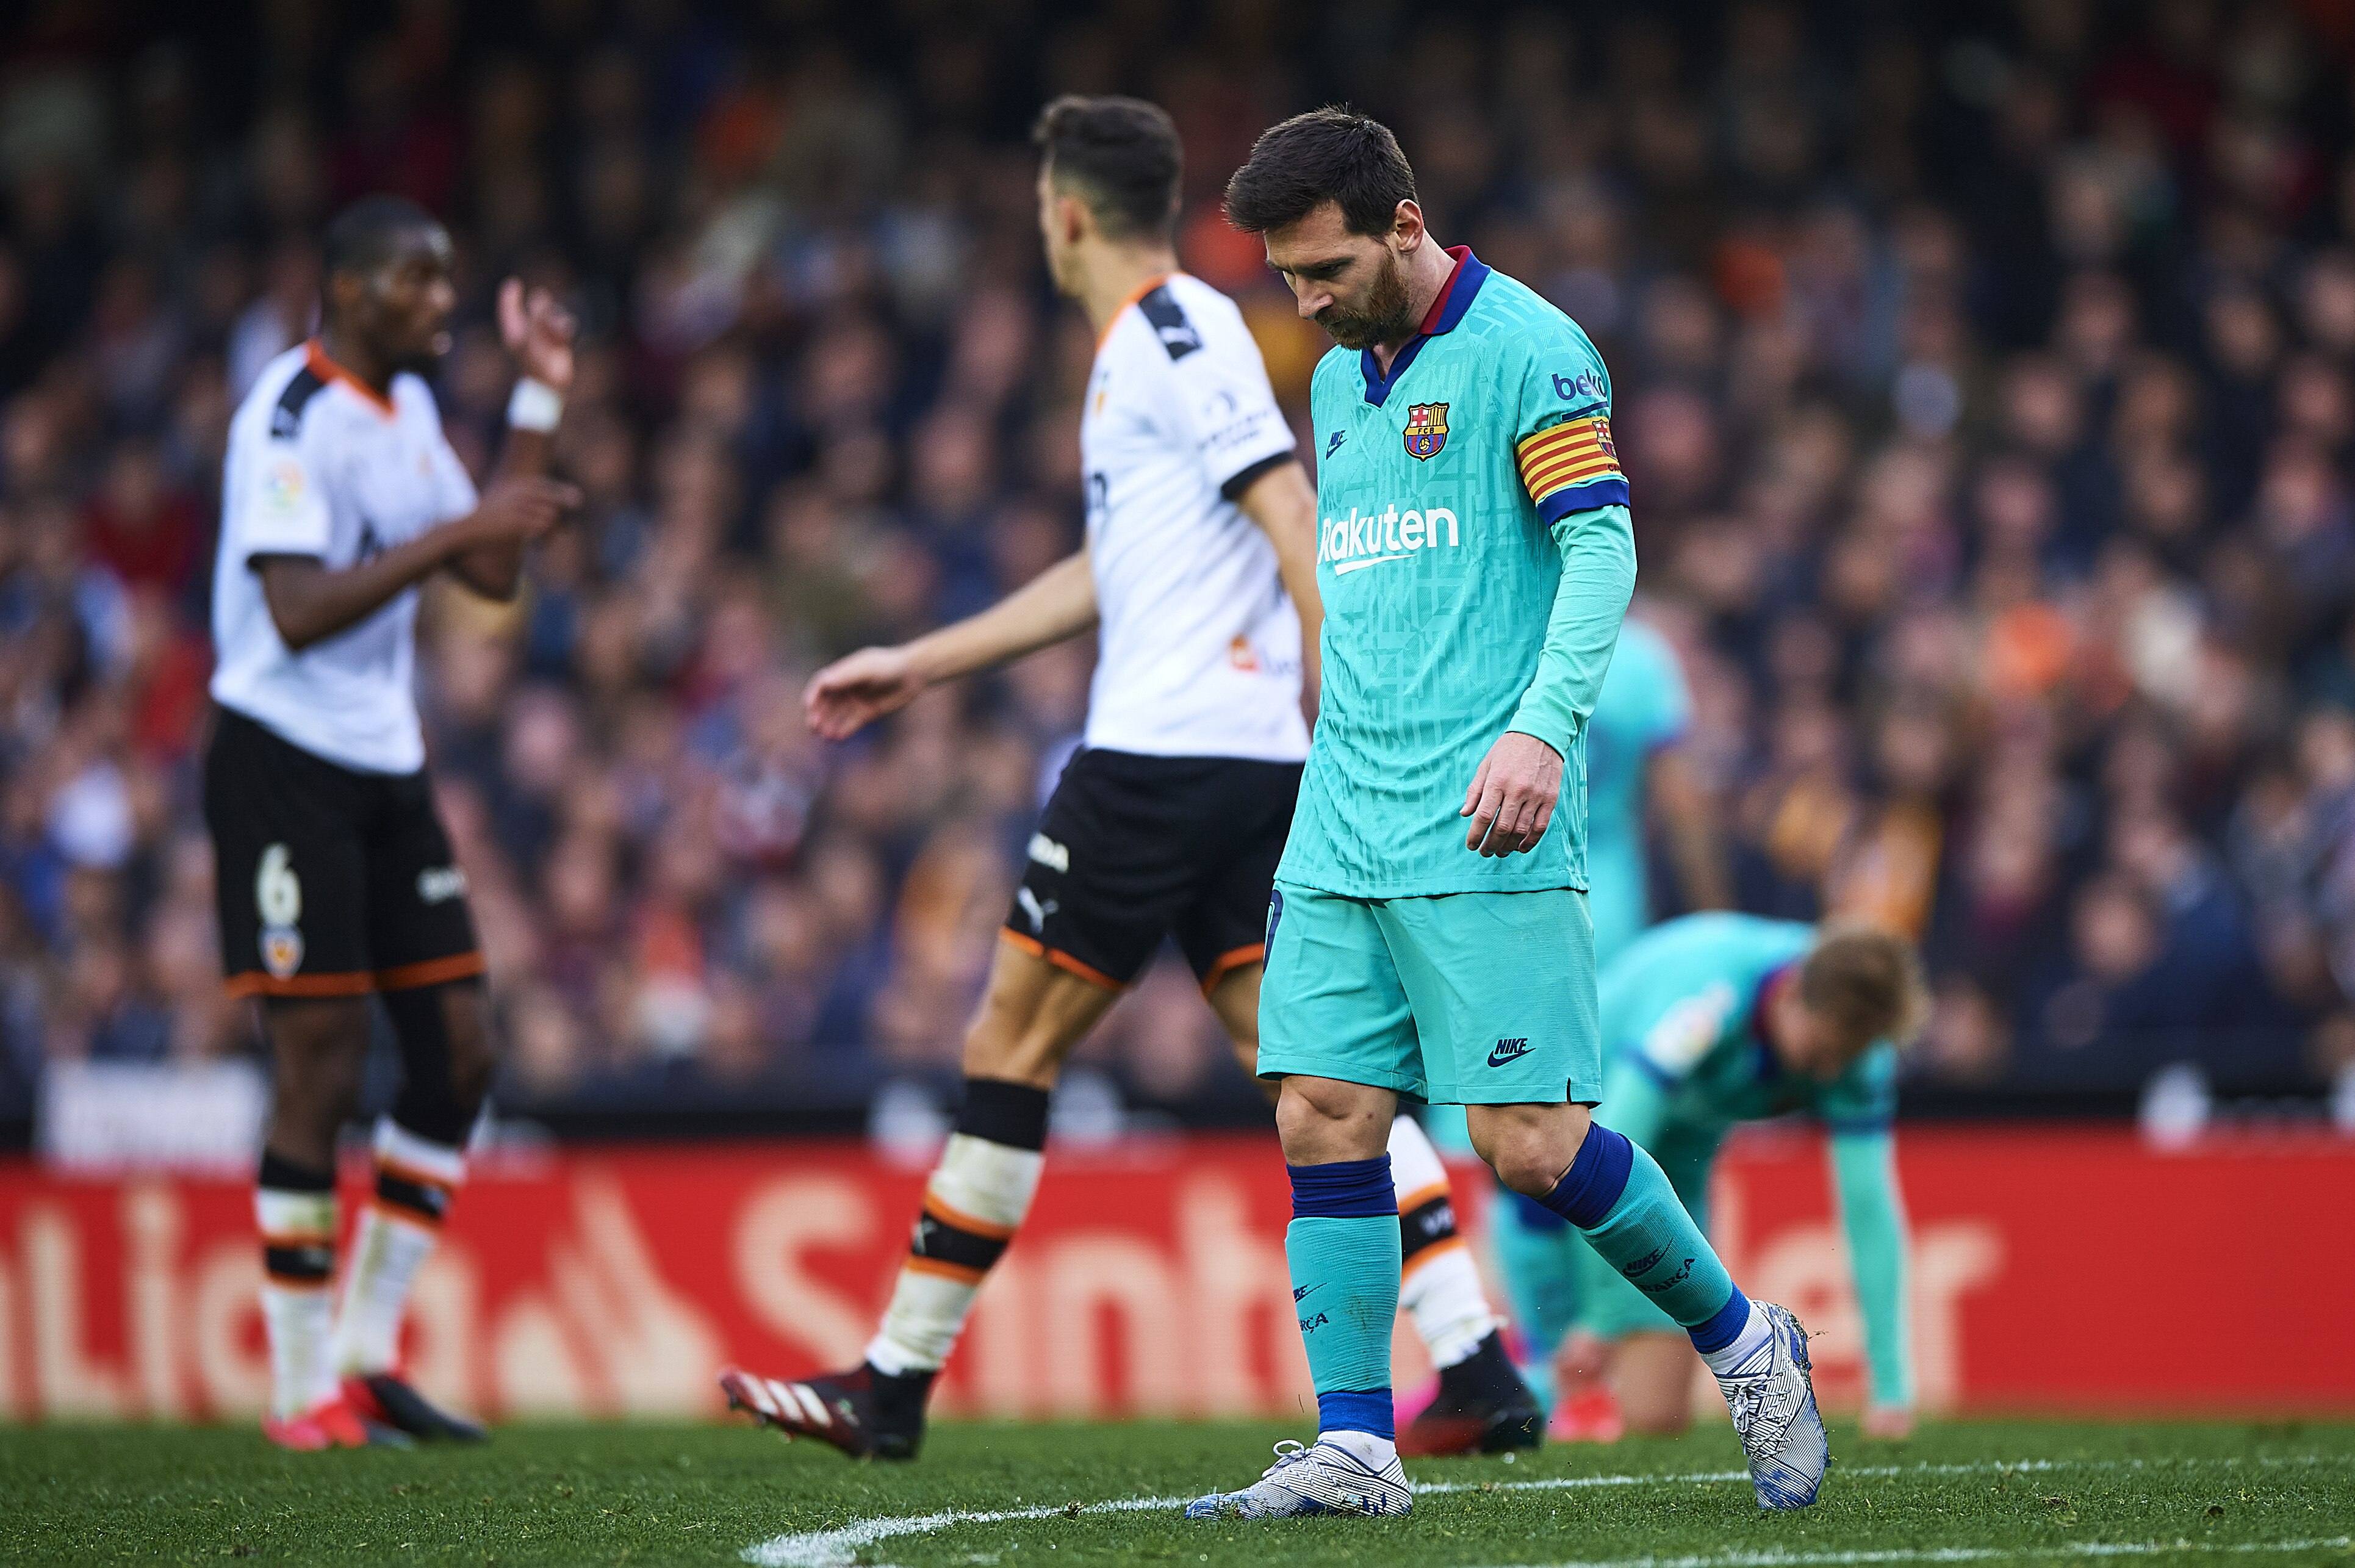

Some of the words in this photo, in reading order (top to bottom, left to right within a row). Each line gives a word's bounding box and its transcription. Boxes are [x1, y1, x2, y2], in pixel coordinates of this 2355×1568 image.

[1551, 369, 1607, 400] beko
[1317, 503, 1459, 565] Rakuten
[255, 841, 303, 926] 6
[1494, 1038, 1528, 1055] NIKE
[1627, 1248, 1660, 1270] NIKE
[1298, 1312, 1329, 1334] RÇA
